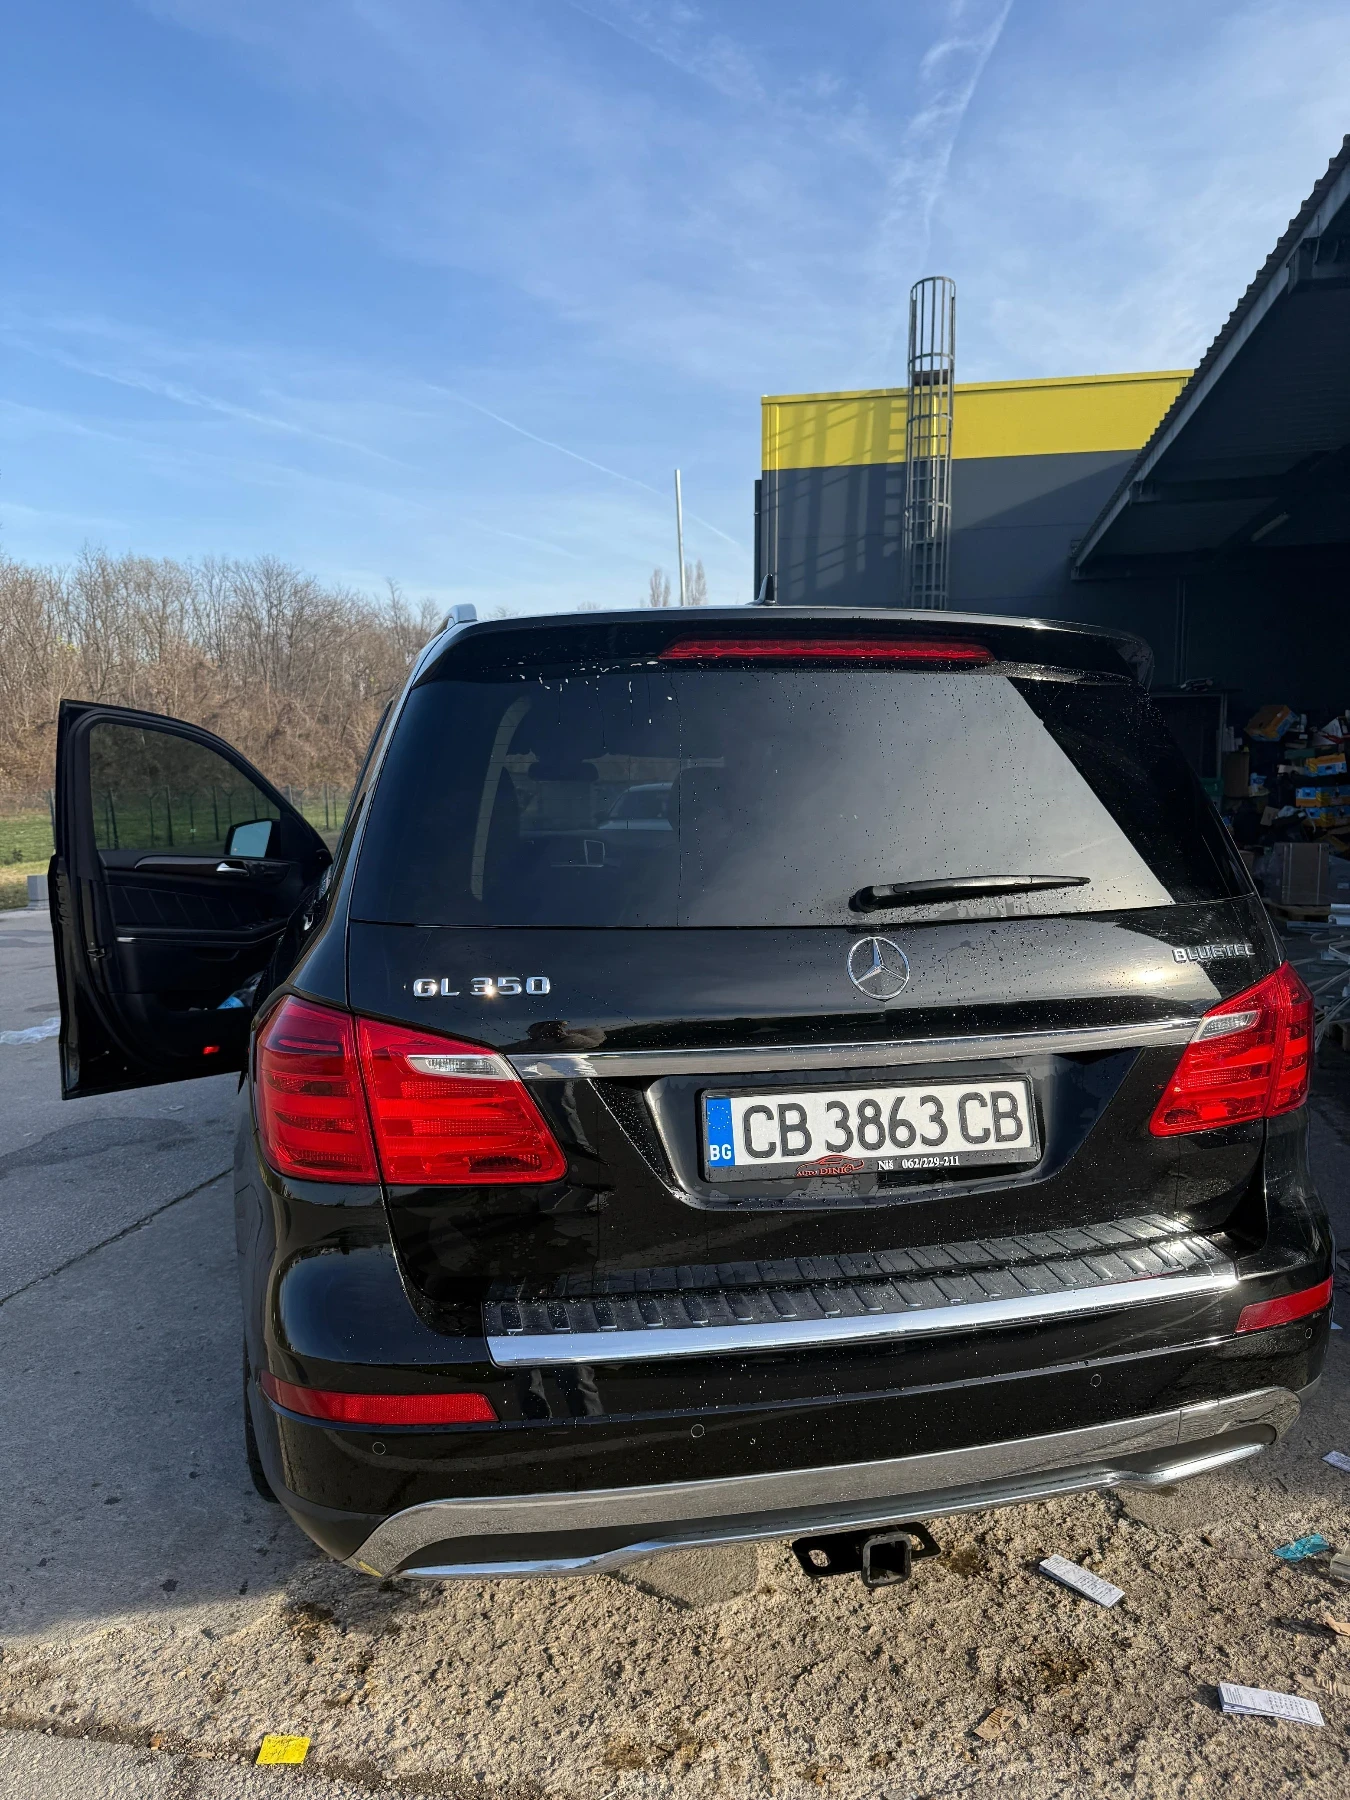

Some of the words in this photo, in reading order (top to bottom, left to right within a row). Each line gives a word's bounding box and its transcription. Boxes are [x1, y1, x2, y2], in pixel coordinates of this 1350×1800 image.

[1172, 943, 1255, 963] BLUETEC
[413, 978, 460, 998] GL
[470, 976, 550, 997] 350
[743, 1103, 812, 1158] CB
[825, 1094, 948, 1153] 3863
[958, 1090, 1024, 1144] CB
[710, 1144, 732, 1161] BG
[878, 1160, 894, 1171] Niš
[901, 1156, 960, 1169] 062/229-211
